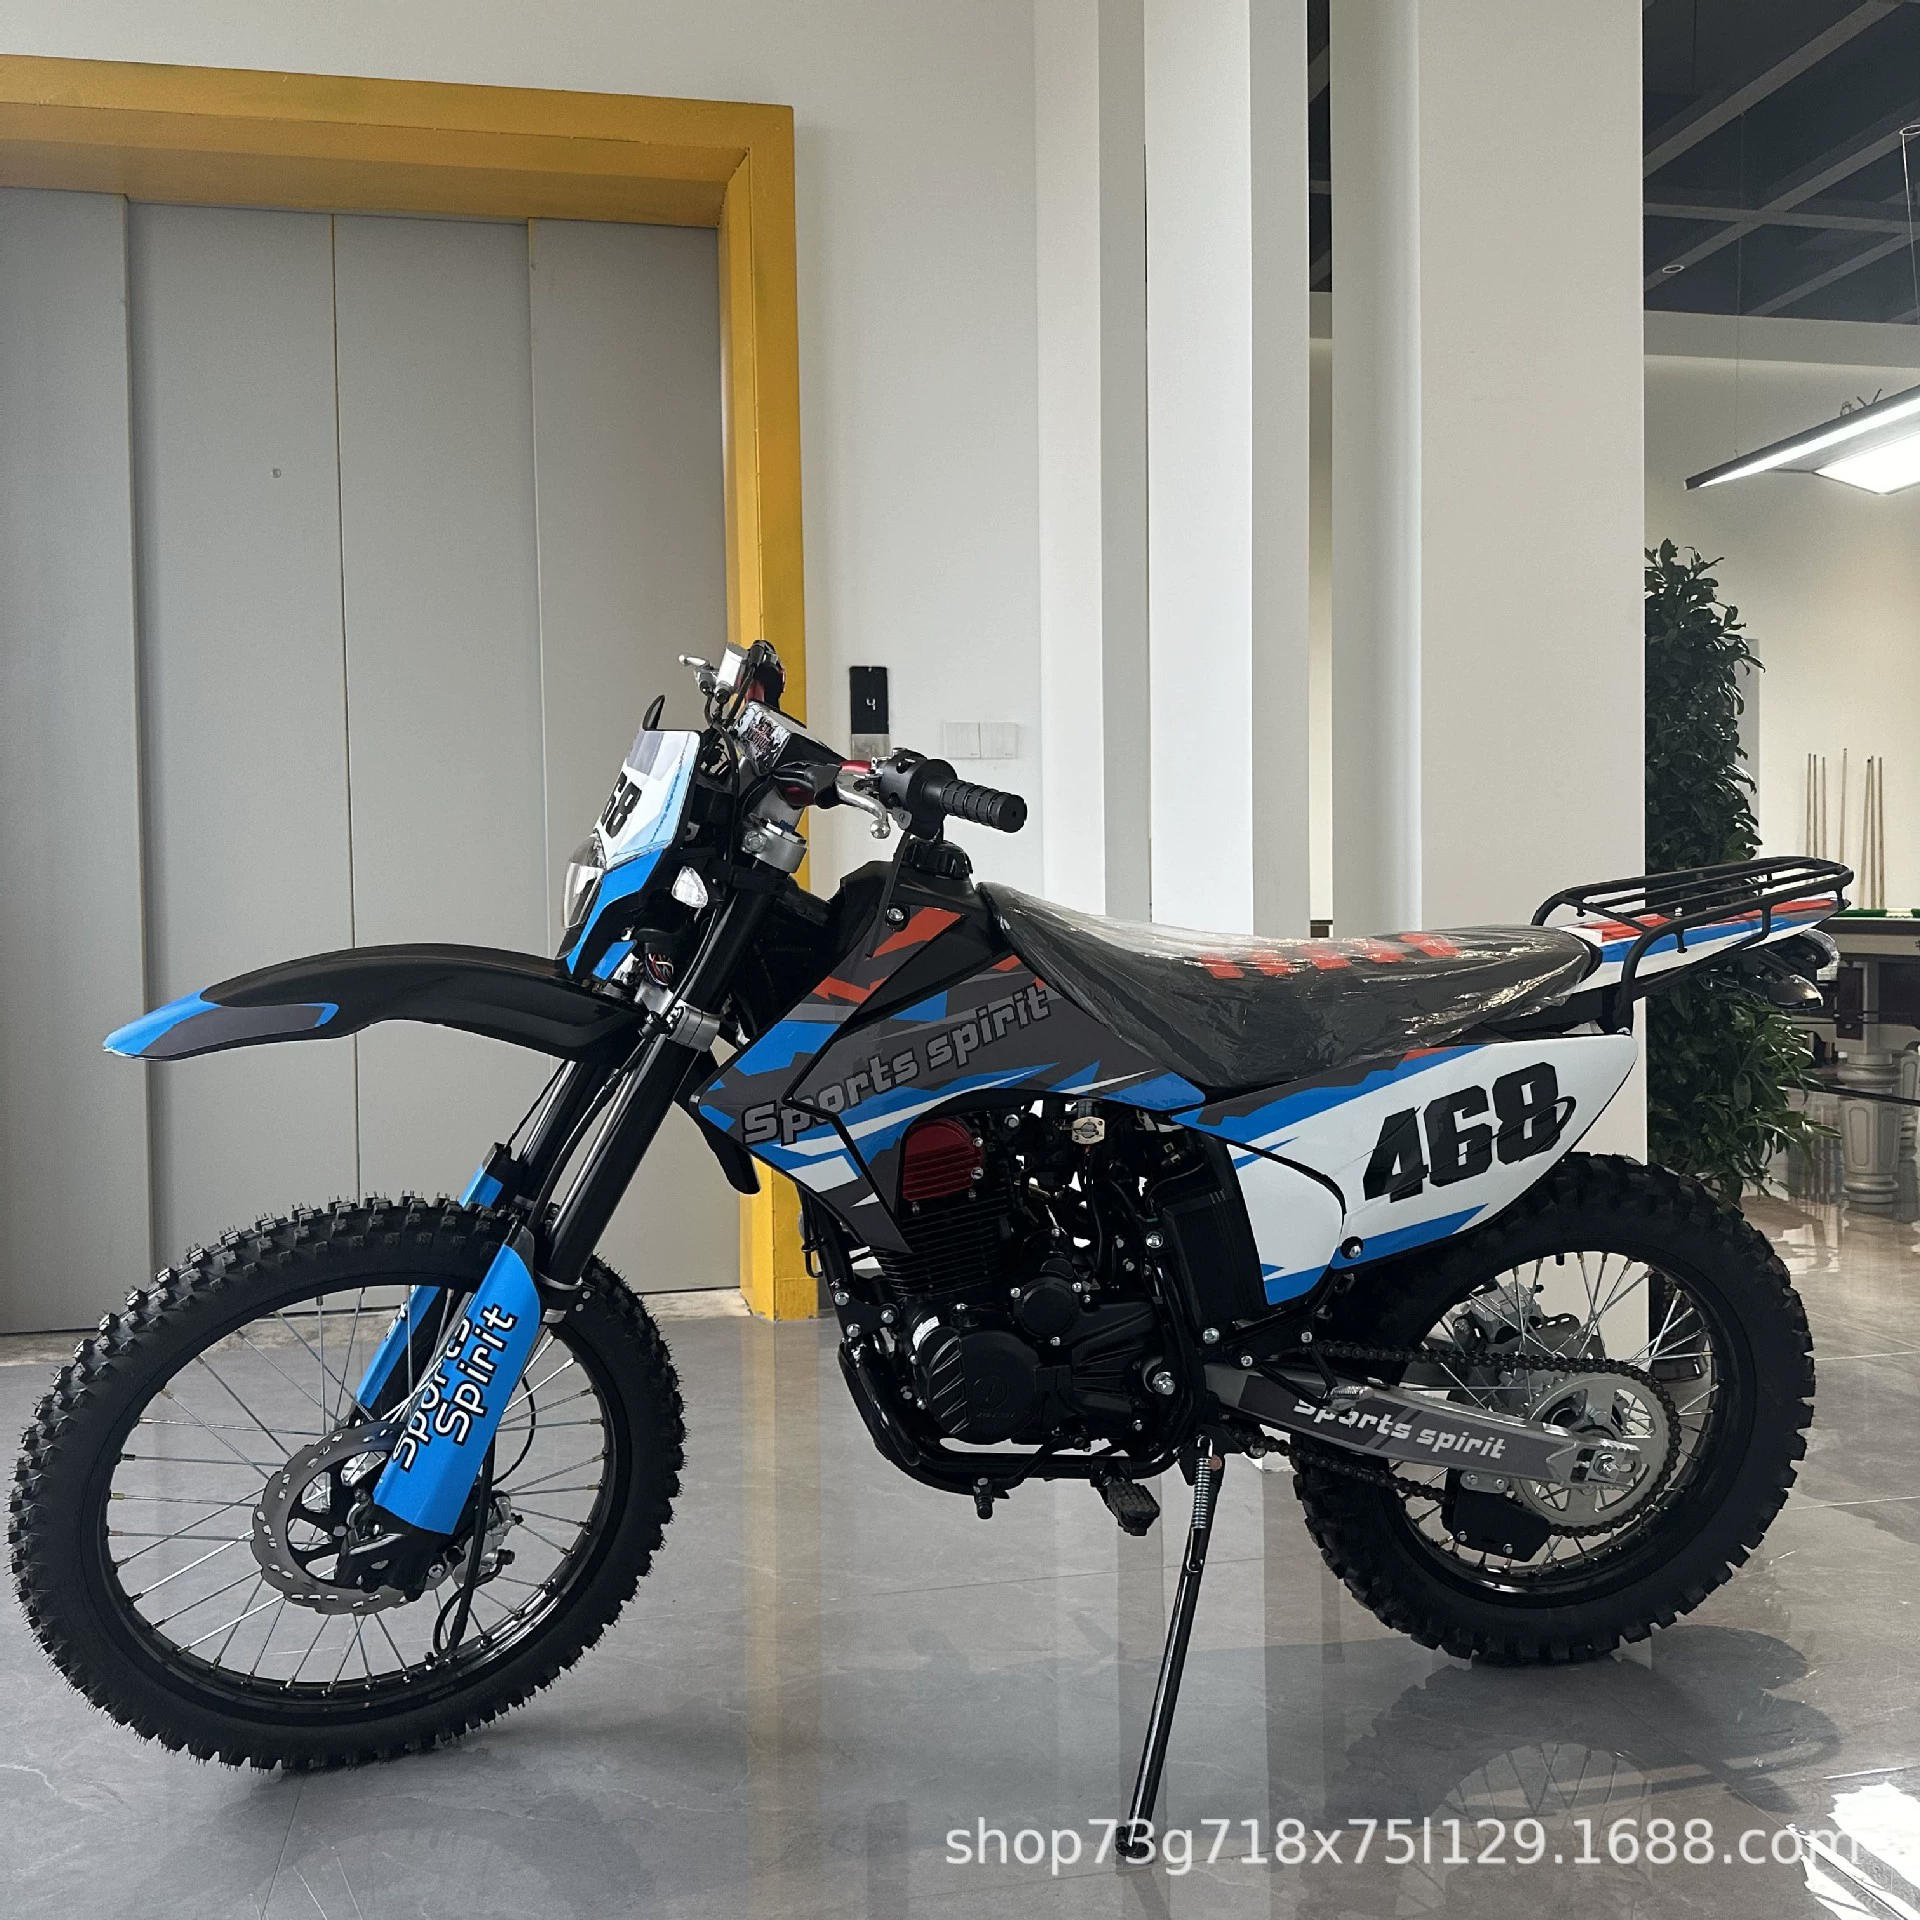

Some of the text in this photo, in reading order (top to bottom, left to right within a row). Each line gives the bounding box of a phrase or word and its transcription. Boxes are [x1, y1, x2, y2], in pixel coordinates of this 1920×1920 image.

[866, 698, 876, 711] 4
[742, 983, 1051, 1147] Sports spirit
[1363, 1062, 1560, 1203] 468
[434, 1304, 519, 1446] Spirit
[1416, 1428, 1506, 1460] spirit
